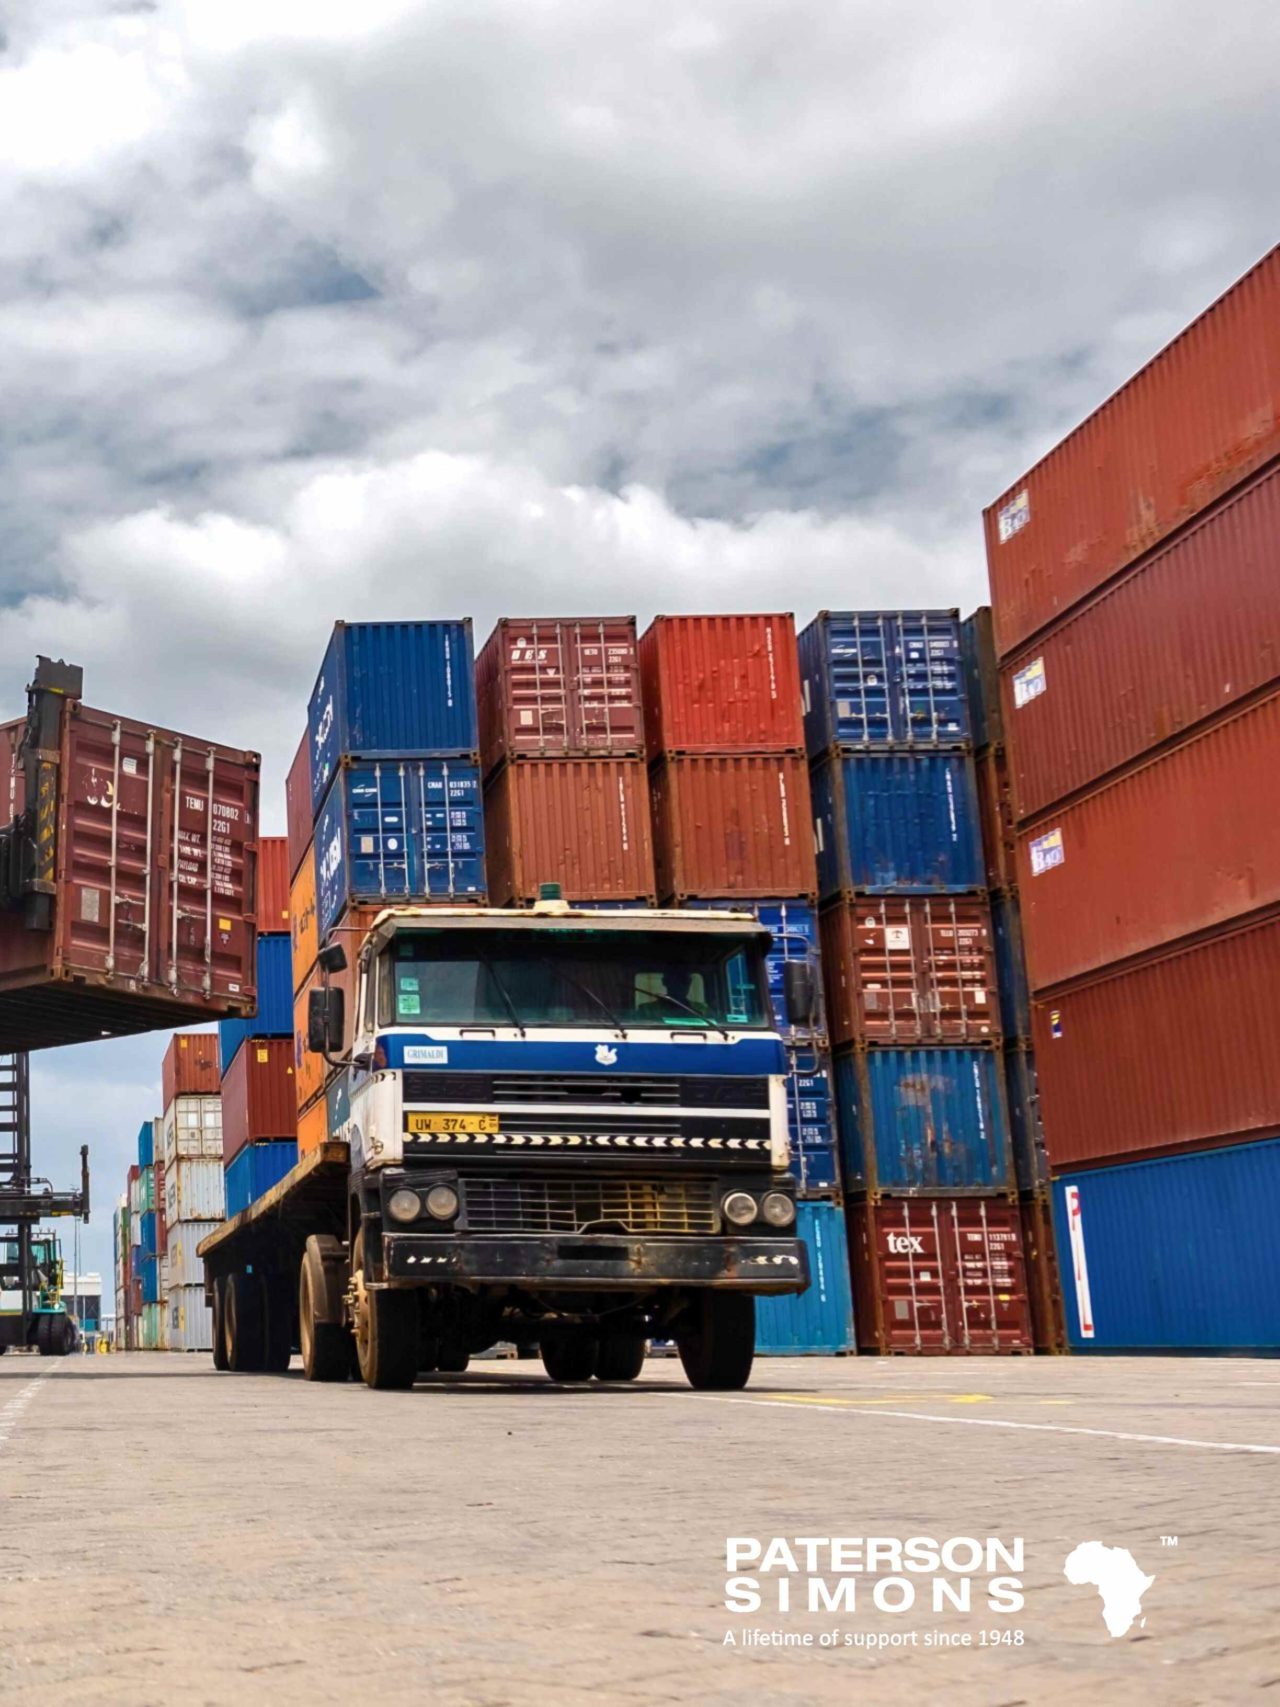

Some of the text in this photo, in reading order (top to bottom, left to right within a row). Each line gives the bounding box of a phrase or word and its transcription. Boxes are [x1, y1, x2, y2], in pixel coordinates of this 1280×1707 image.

[185, 796, 204, 812] TEMU
[406, 1049, 444, 1060] GRIMALDI
[415, 1118, 432, 1131] UW
[442, 1118, 466, 1131] 374
[478, 1118, 487, 1131] C
[886, 1231, 925, 1254] tex
